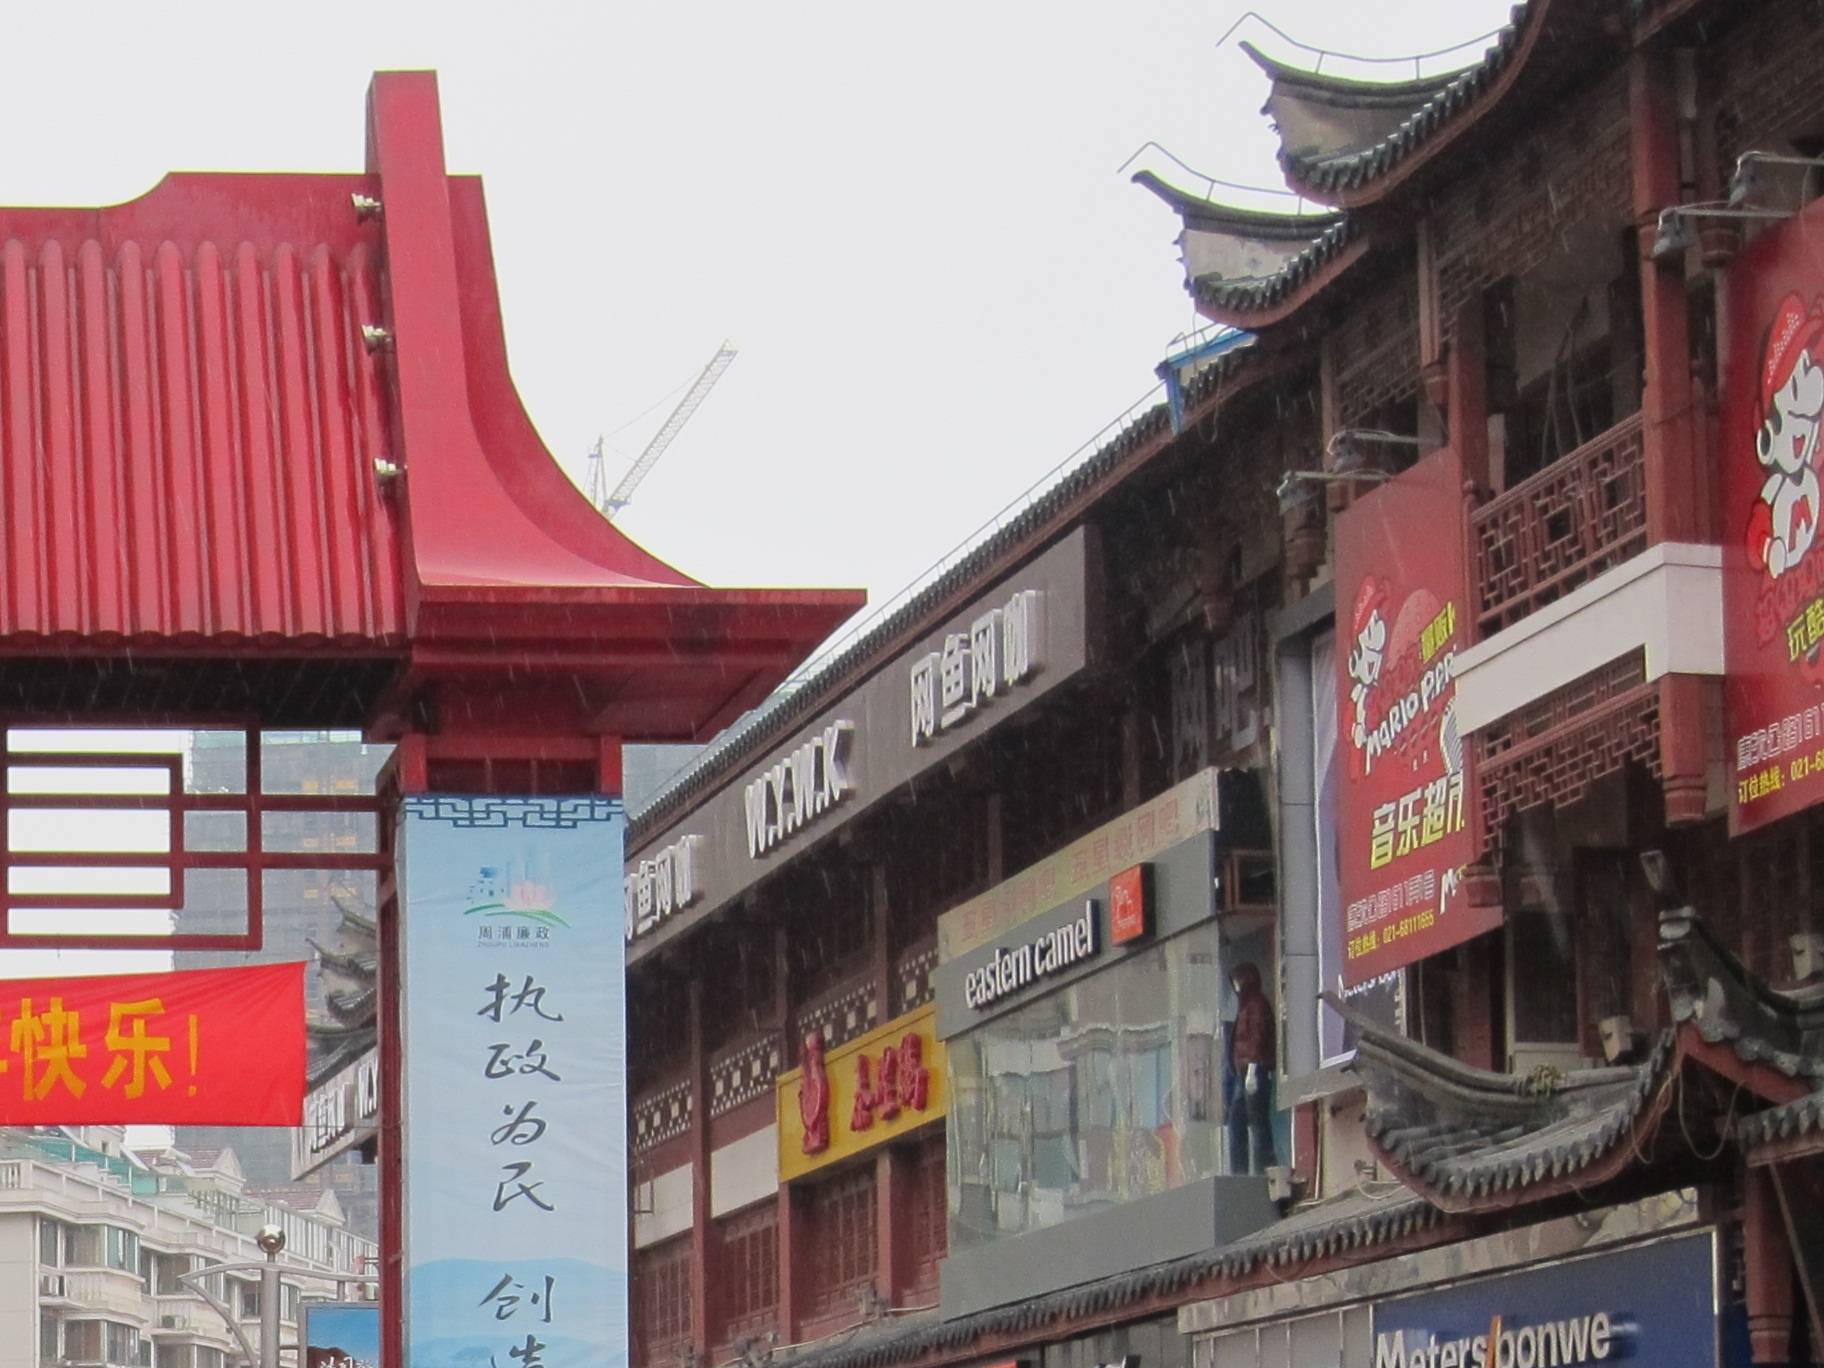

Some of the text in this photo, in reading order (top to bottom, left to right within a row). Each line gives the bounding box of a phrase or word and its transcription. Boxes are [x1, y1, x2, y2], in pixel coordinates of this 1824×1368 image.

[1365, 644, 1457, 775] MARIO PAR
[479, 925, 550, 939] 周浦廉政
[965, 945, 1032, 1009] eastern
[1034, 899, 1093, 977] camel
[478, 972, 565, 1213] 执政为民
